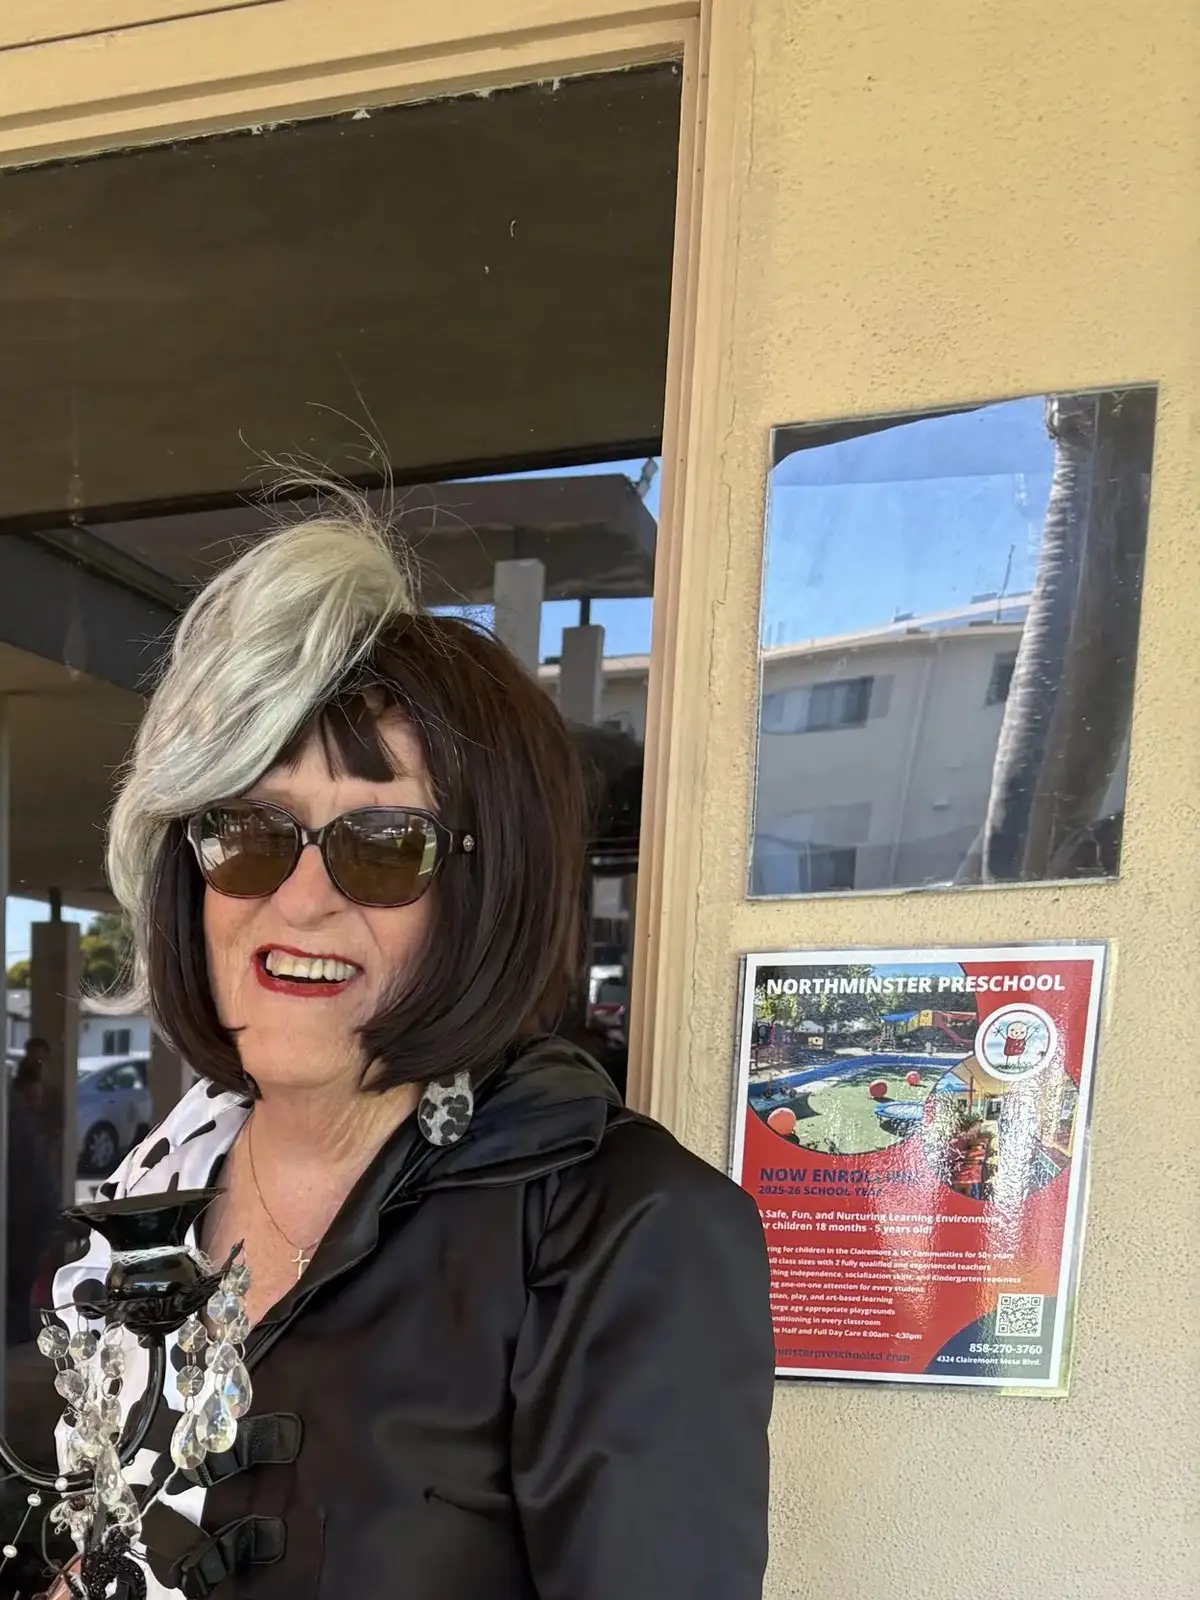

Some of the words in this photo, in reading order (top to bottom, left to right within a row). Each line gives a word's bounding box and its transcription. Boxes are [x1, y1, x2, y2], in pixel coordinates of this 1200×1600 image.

[766, 977, 938, 995] NORTHMINSTER
[938, 974, 1066, 993] PRESCHOOL
[760, 1168, 808, 1182] NOW
[758, 1185, 801, 1195] 2025-26
[803, 1186, 850, 1196] SCHOOL
[765, 1209, 789, 1220] Safe,
[791, 1210, 812, 1221] Fun,
[815, 1211, 834, 1220] and
[836, 1211, 887, 1223] Nurturing
[889, 1213, 933, 1224] Learning
[772, 1221, 813, 1231] children
[815, 1222, 827, 1231] 18
[829, 1223, 867, 1233] months
[874, 1224, 881, 1233] 5
[883, 1225, 914, 1236] years
[914, 1225, 933, 1235] old!
[795, 1246, 826, 1254] children
[912, 1250, 963, 1258] Communities
[840, 1260, 858, 1269] fully
[858, 1260, 892, 1270] qualified
[909, 1262, 956, 1272] experienced
[957, 1263, 991, 1271] teachers
[931, 1274, 984, 1284] Kindergarten
[780, 1282, 822, 1290] one-on-one
[823, 1282, 858, 1291] attention
[859, 1283, 871, 1291] for
[872, 1285, 894, 1293] every
[790, 1293, 809, 1303] play,
[810, 1294, 825, 1302] and
[825, 1295, 860, 1303] art-based
[861, 1296, 894, 1305] learning
[790, 1306, 803, 1314] age
[804, 1306, 848, 1316] appropriate
[849, 1307, 896, 1317] playgrounds
[821, 1318, 843, 1327] every
[843, 1318, 881, 1326] classroom
[781, 1327, 798, 1335] Half
[798, 1328, 812, 1336] and
[813, 1328, 828, 1336] Full
[828, 1329, 843, 1339] Day
[843, 1330, 862, 1338] Care
[968, 1342, 1043, 1355] 858-270-3760
[936, 1355, 955, 1364] 4324
[955, 1356, 998, 1365] Clairemont
